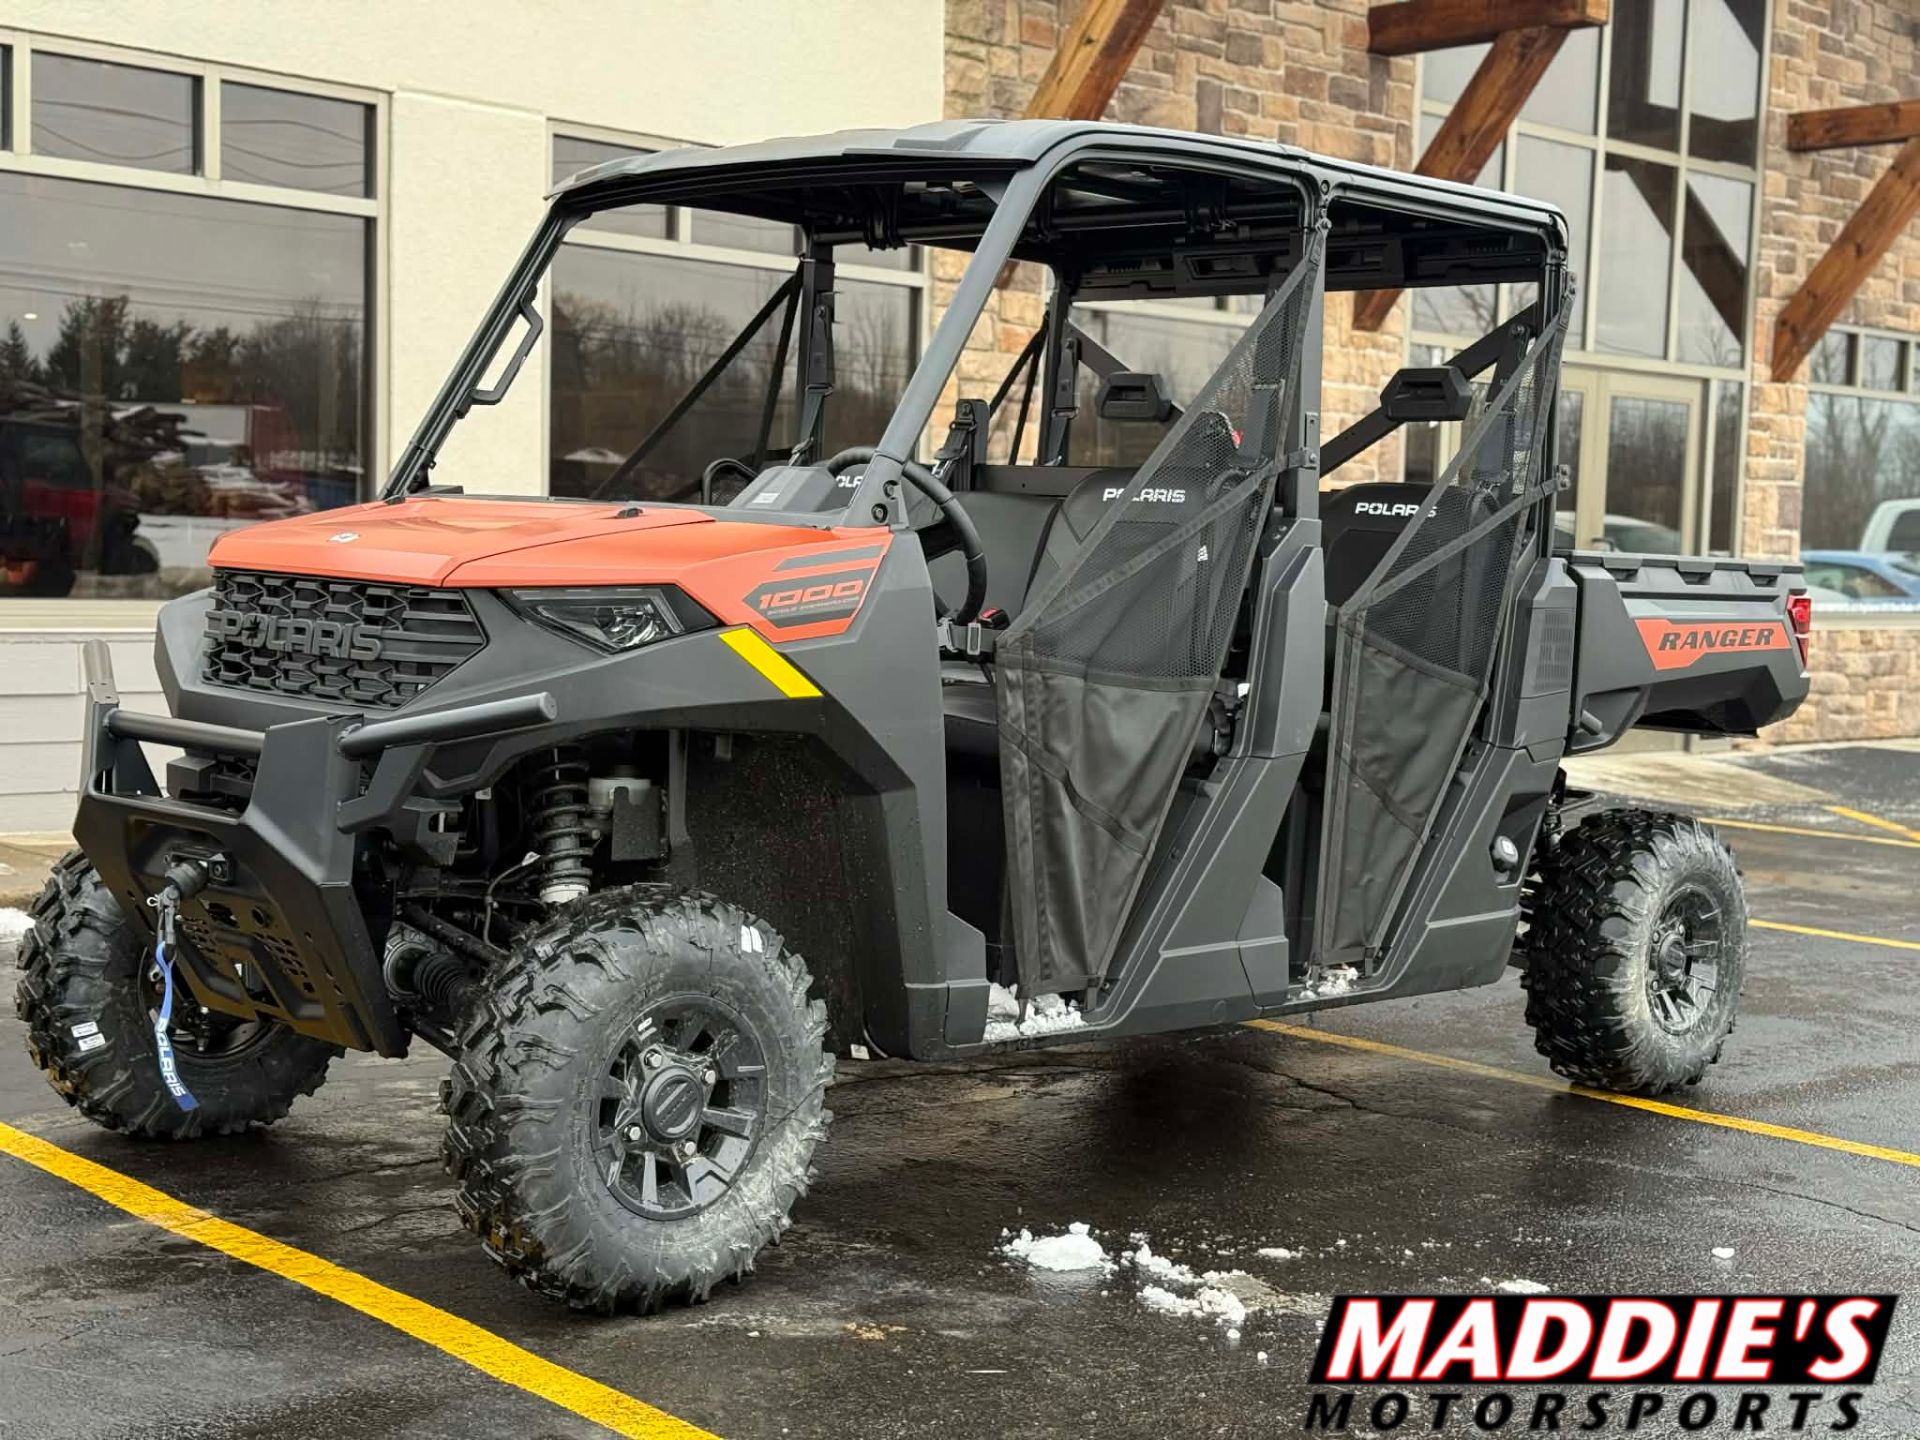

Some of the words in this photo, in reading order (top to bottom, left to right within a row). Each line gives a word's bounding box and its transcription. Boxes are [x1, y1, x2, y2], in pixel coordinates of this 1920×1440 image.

[1354, 502, 1438, 518] POLARS
[760, 579, 864, 609] 1000
[217, 609, 382, 661] POLARIS
[1658, 628, 1774, 651] RANGER
